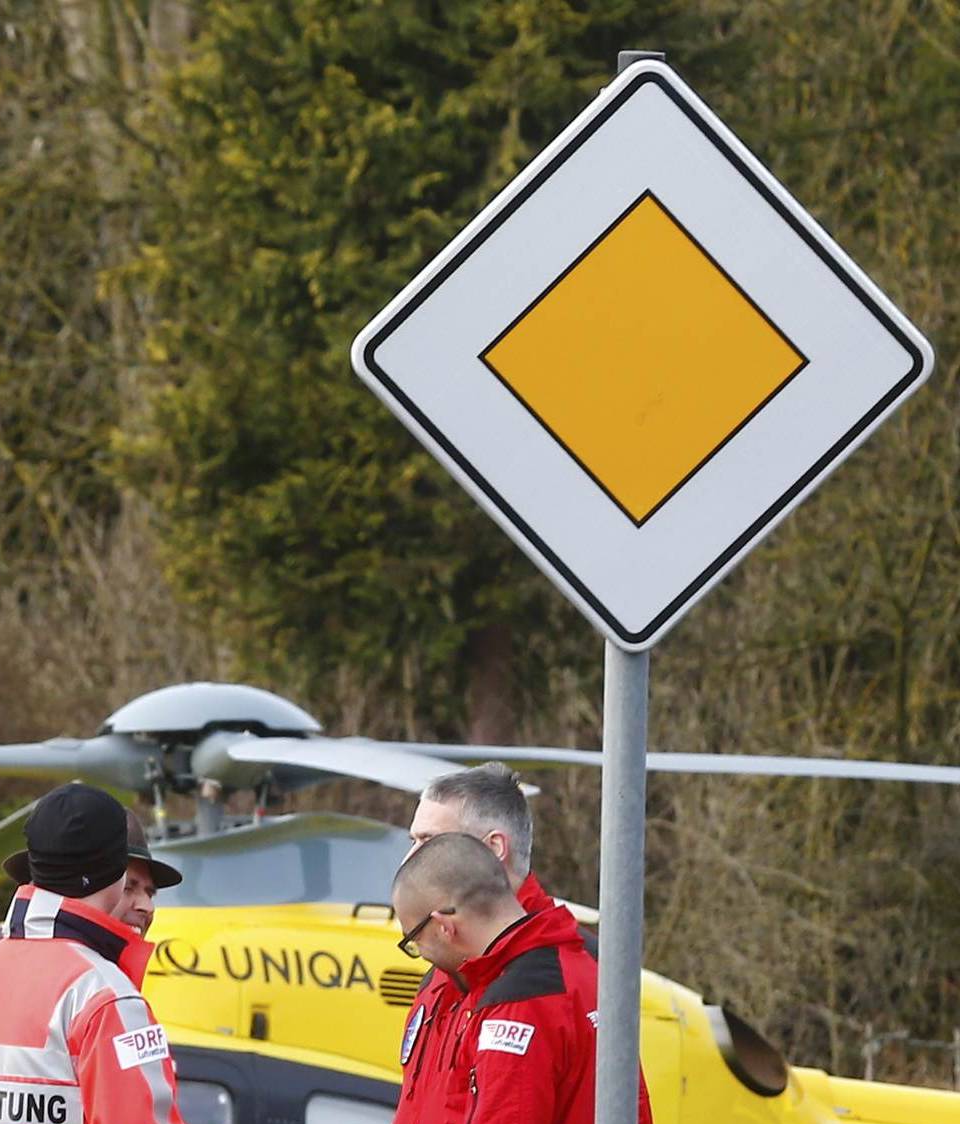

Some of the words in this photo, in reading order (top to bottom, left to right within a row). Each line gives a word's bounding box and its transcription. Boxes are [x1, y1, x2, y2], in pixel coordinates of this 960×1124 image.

[221, 946, 375, 991] UNIQA
[134, 1027, 163, 1051] DRF
[494, 1023, 531, 1042] DRF
